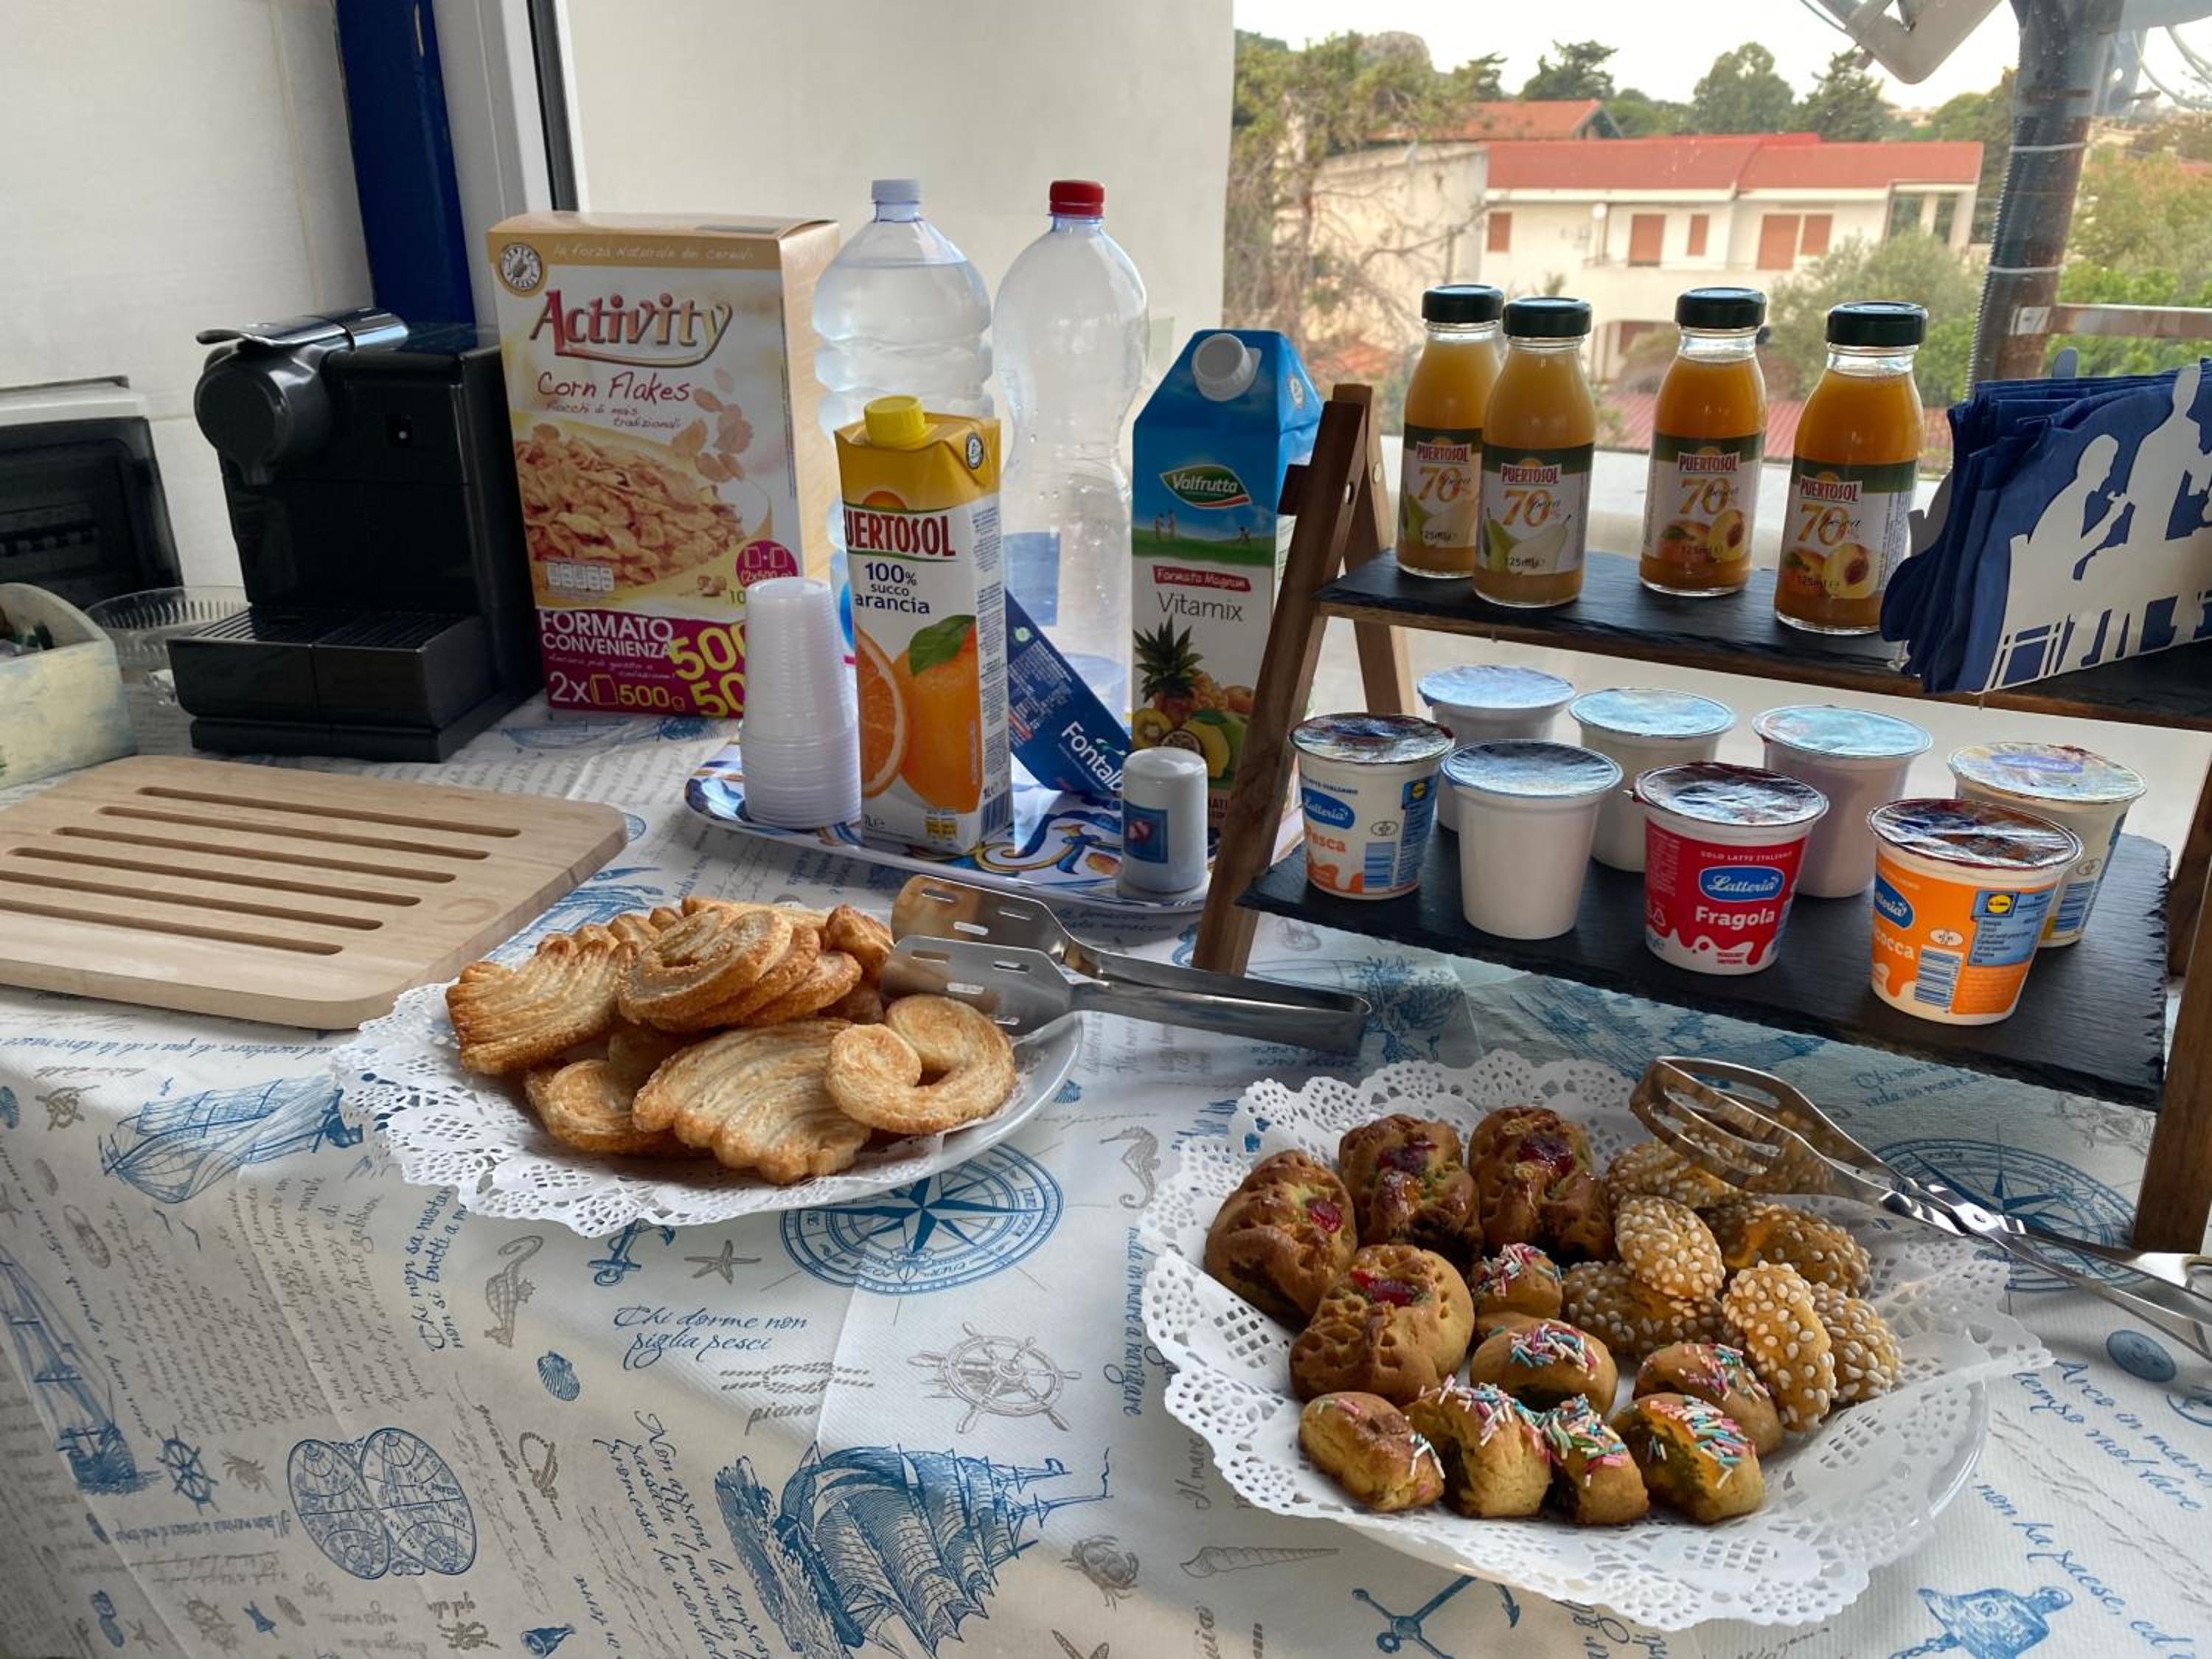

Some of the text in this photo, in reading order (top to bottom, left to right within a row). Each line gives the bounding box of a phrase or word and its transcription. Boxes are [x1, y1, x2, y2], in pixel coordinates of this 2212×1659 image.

[529, 289, 734, 364] Activity
[538, 371, 690, 405] Corn Flakes
[1417, 445, 1469, 462] PUERTOSOL
[1679, 455, 1738, 472] PUERTOSOL
[1172, 473, 1239, 494] Valfrutta
[1419, 466, 1464, 503] 70
[1502, 465, 1559, 484] PUERTOSOL
[1800, 478, 1859, 502] PUERTOSOL
[1503, 489, 1552, 527] 70
[1680, 476, 1730, 515] 70
[1798, 503, 1850, 546] 70
[864, 562, 918, 586] 100%
[871, 581, 910, 597] succo
[855, 592, 931, 615] arancia
[1158, 591, 1244, 622] Vitamix
[540, 609, 673, 642] FORMATO
[542, 632, 673, 658] CONVENIENZA
[550, 670, 590, 703] 2x
[1706, 874, 1778, 894] Latteria
[1696, 905, 1776, 931] Fragola
[406, 1231, 422, 1253] sa
[417, 1233, 451, 1283] butti
[405, 1257, 422, 1300] non
[1127, 1264, 1147, 1284] in
[613, 1304, 809, 1329] Chi dorme non
[1125, 1285, 1144, 1323] mare
[414, 1304, 446, 1352] Chi
[1124, 1325, 1143, 1338] a
[623, 1326, 773, 1371] piglia pesci
[1104, 1341, 1147, 1417] navigare
[2012, 1371, 2084, 1424] tempo
[744, 1402, 821, 1437] piano
[2053, 1360, 2212, 1489] Arco in mare
[1188, 1438, 1206, 1477] mare
[615, 1439, 675, 1526] passata
[634, 1408, 678, 1474] Non
[661, 1477, 712, 1551] appena
[708, 1557, 734, 1576] la
[592, 1439, 659, 1543] promessa
[653, 1547, 679, 1576] ha
[1973, 1482, 2018, 1516] non
[2012, 1522, 2054, 1545] ha
